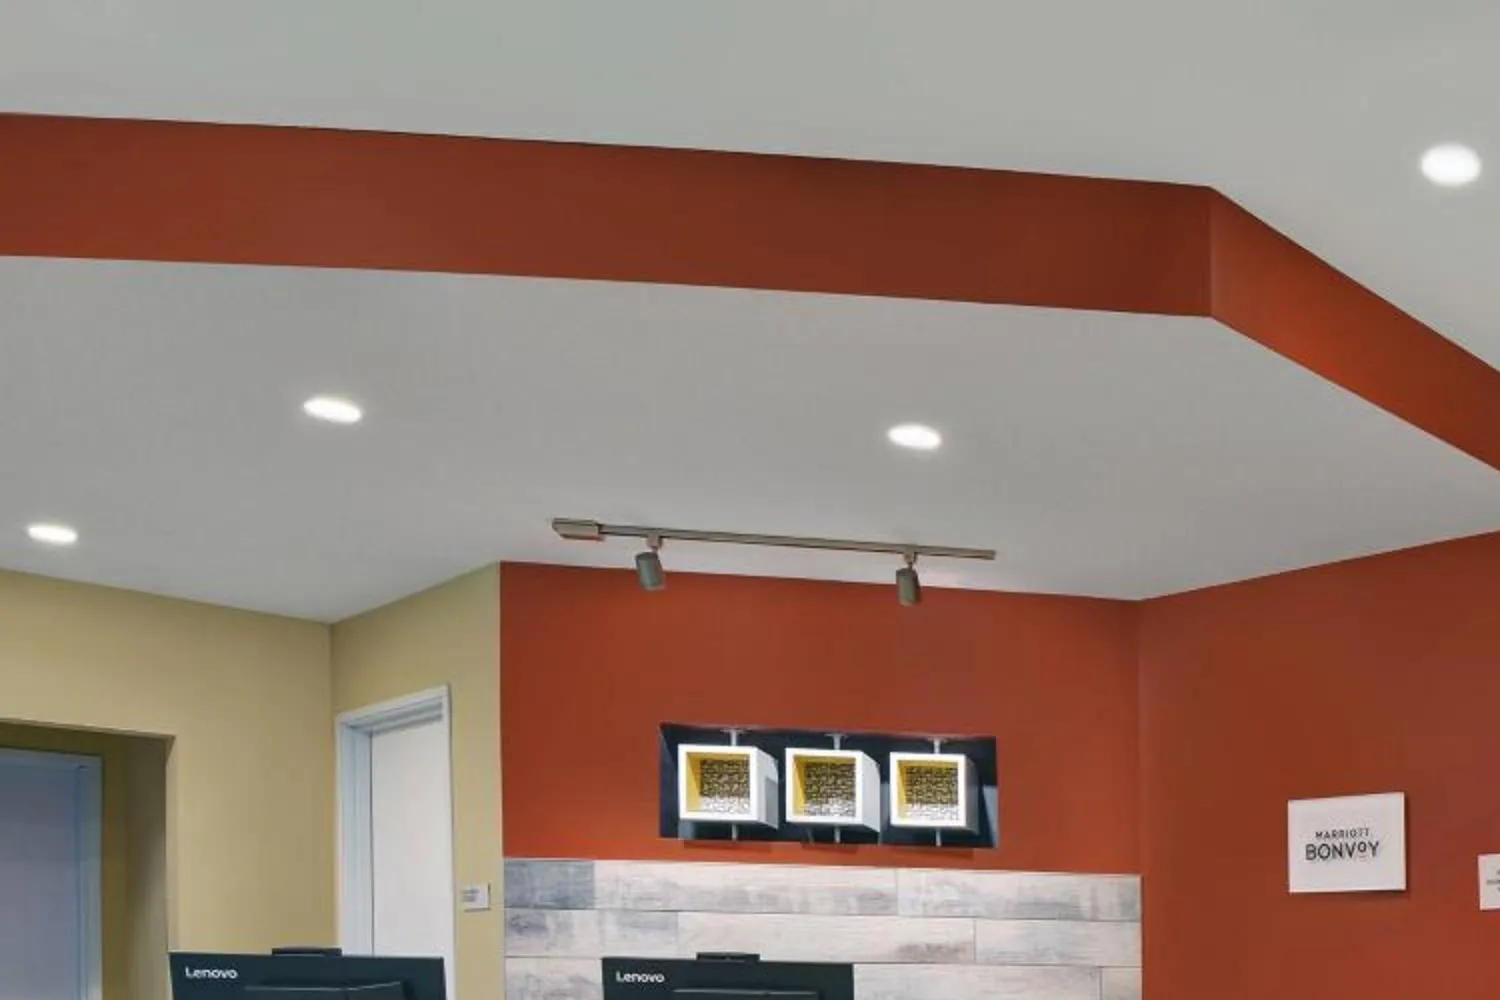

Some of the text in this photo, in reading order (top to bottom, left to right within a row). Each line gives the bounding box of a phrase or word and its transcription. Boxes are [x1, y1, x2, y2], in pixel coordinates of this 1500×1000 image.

[1315, 828, 1370, 839] MARRIOTT
[1305, 841, 1379, 861] BONVOY
[185, 966, 238, 979] Lenovo
[615, 970, 665, 983] Lenovo
